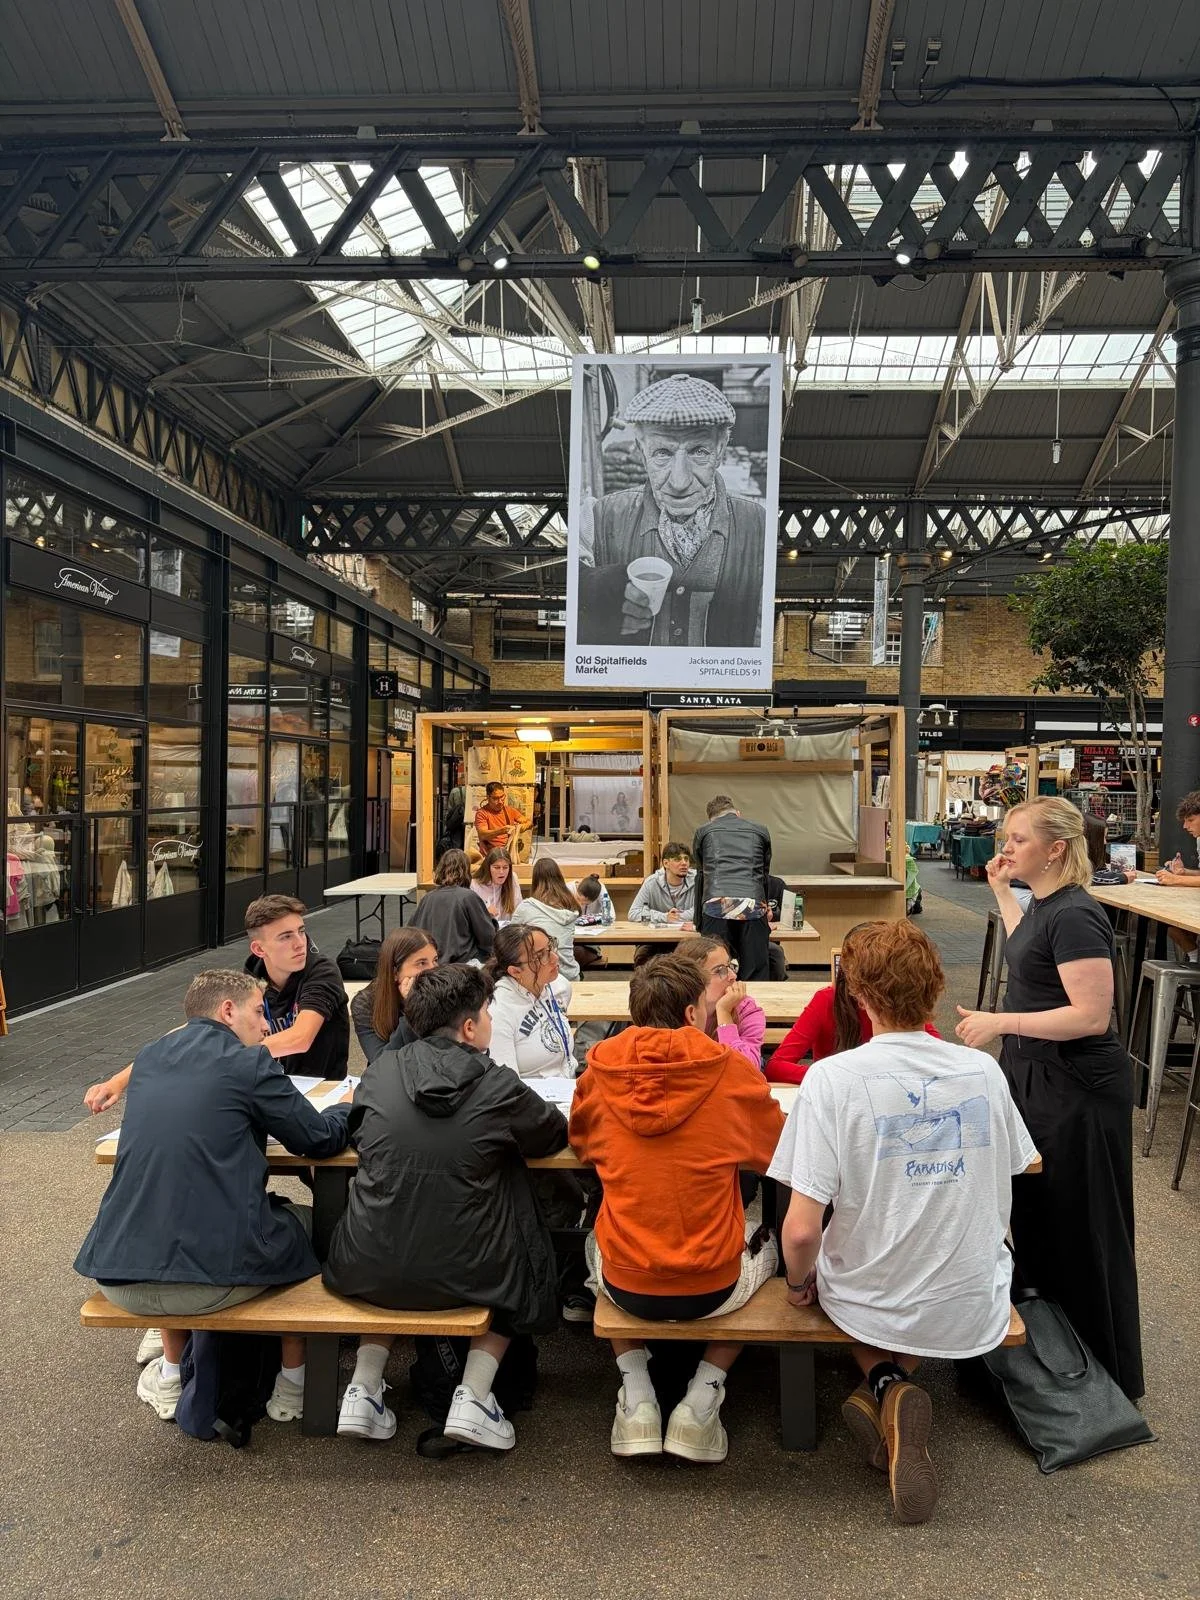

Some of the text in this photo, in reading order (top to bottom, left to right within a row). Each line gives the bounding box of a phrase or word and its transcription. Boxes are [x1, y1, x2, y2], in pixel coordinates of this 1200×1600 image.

[54, 567, 119, 605] American Vintage
[575, 655, 648, 666] Old Spitalfields
[688, 657, 762, 666] Jackson and Davies
[575, 665, 608, 674] Market
[699, 667, 761, 676] SPITALFIELDS 91
[680, 695, 742, 705] SANTA NATA
[904, 1155, 966, 1180] PARADISA
